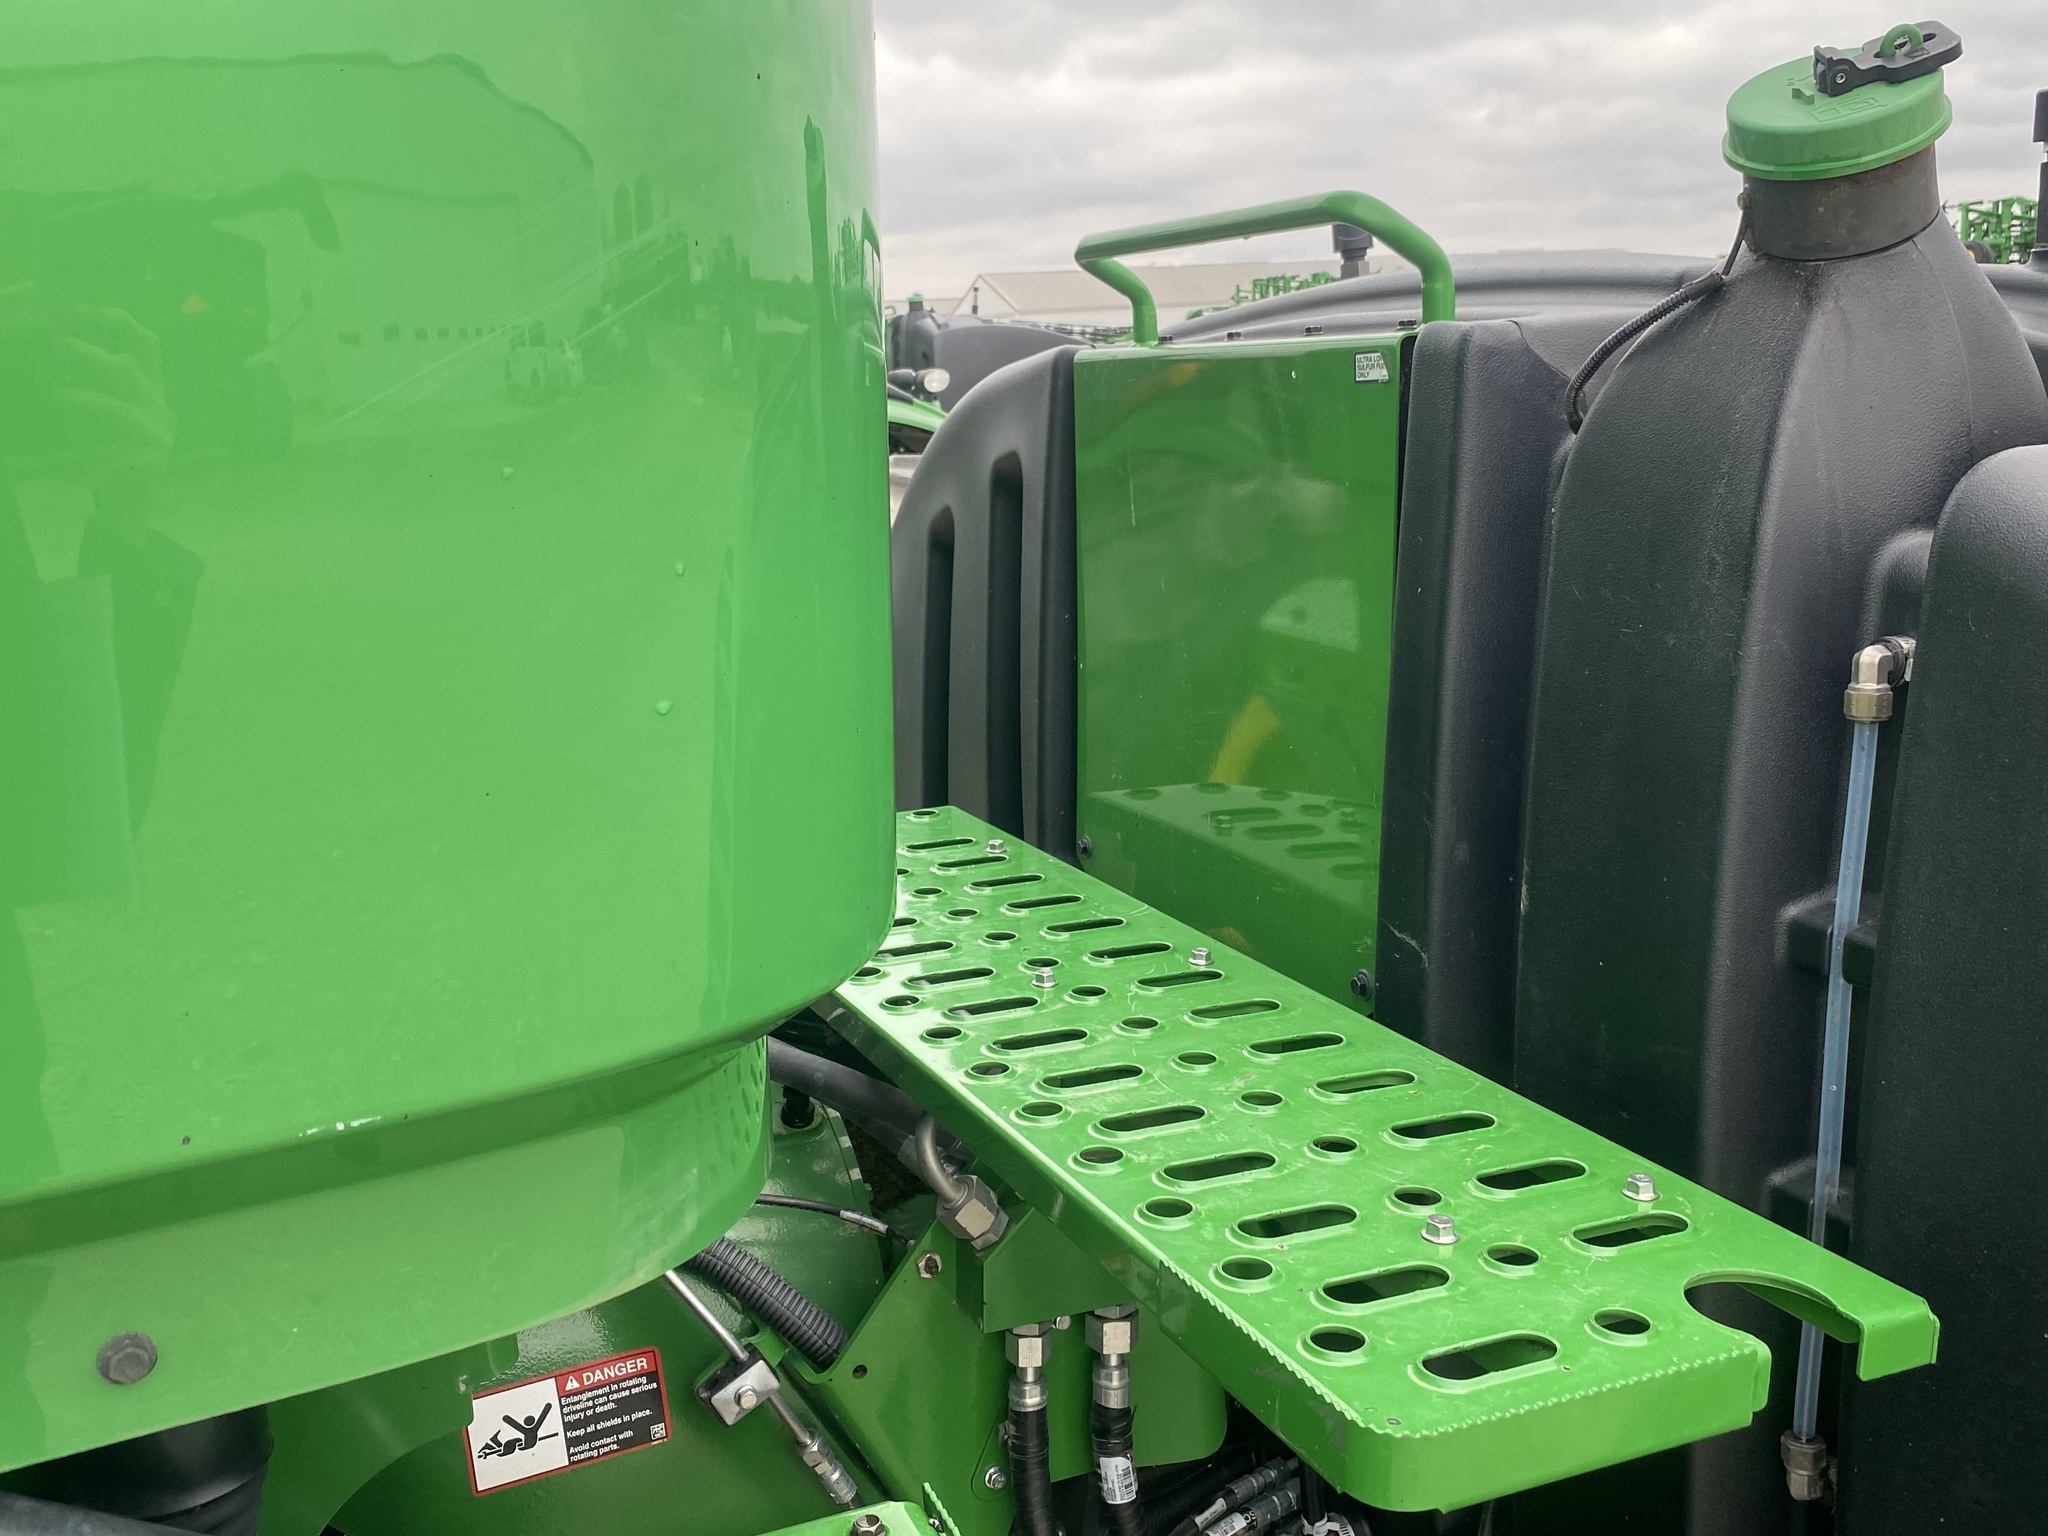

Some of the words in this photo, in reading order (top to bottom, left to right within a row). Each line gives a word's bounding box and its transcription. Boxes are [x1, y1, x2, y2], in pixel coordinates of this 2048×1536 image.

[582, 1357, 648, 1386] DANGER
[561, 1385, 610, 1405] Entanglement
[610, 1384, 618, 1392] in
[619, 1376, 647, 1389] rotating
[562, 1399, 593, 1414] driveline
[594, 1396, 608, 1405] can
[609, 1390, 630, 1400] cause
[631, 1382, 658, 1394] serious
[563, 1411, 585, 1423] injury
[585, 1408, 594, 1416] or
[595, 1402, 618, 1414] death.
[566, 1428, 585, 1438] Keep
[586, 1425, 596, 1433] all
[596, 1417, 622, 1430] shields
[623, 1414, 630, 1422] in
[631, 1408, 653, 1421] place.
[569, 1443, 590, 1454] Avoid
[590, 1435, 617, 1448] contact
[618, 1429, 634, 1440] with
[570, 1449, 598, 1462] rotating
[599, 1443, 620, 1455] parts.
